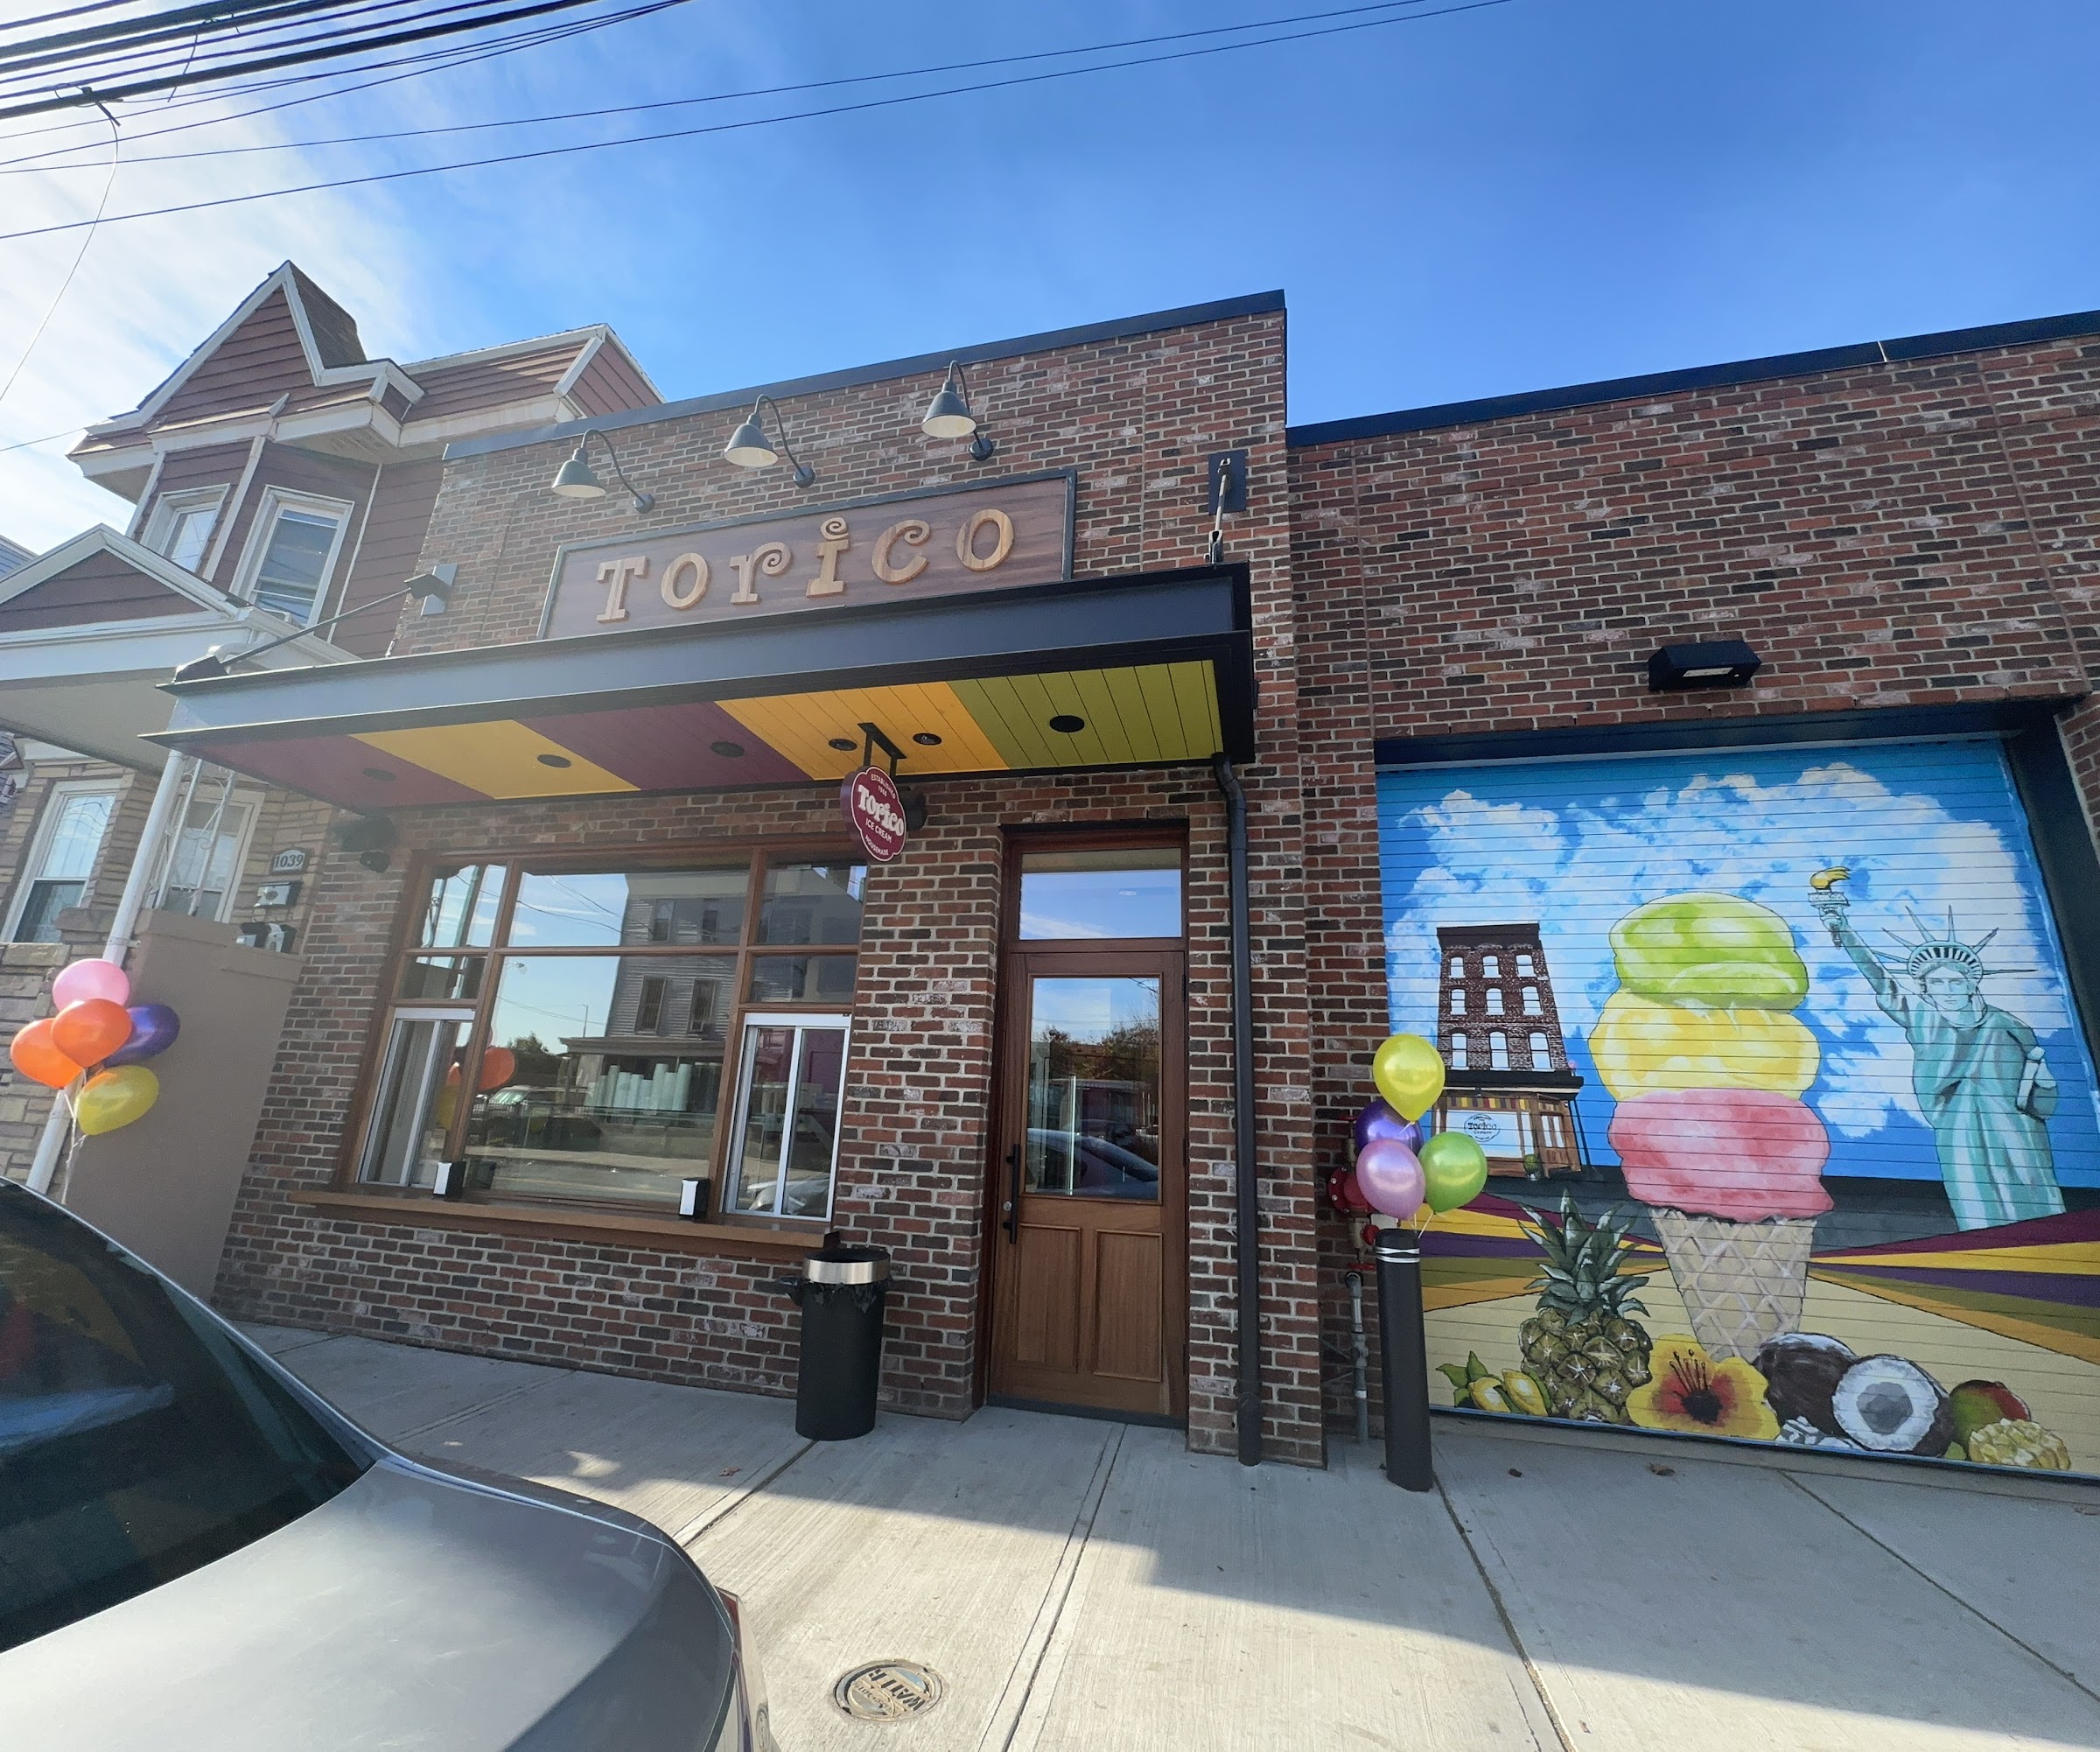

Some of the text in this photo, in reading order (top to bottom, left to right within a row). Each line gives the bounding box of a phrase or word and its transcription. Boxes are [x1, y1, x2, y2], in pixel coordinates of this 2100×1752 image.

[865, 817, 892, 843] ICE CREAM
[864, 834, 889, 856] HOMEMADE
[274, 854, 304, 868] 1039
